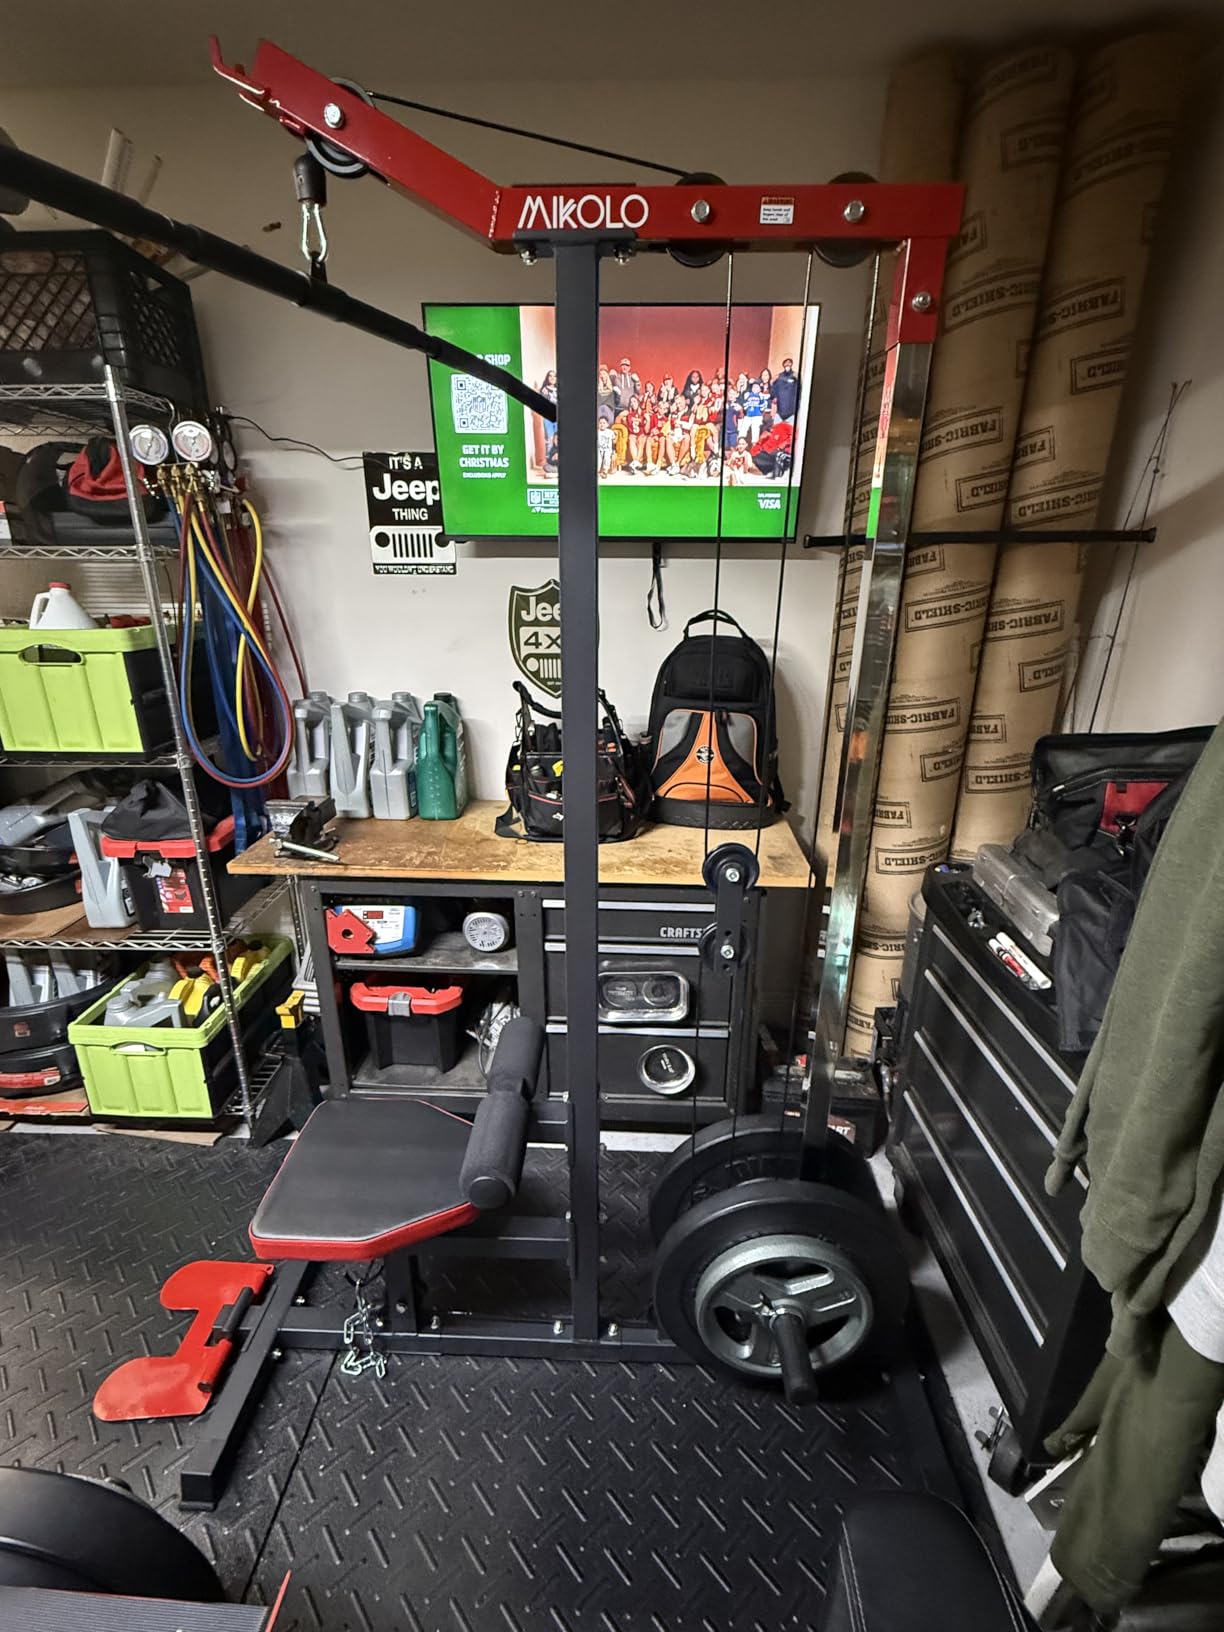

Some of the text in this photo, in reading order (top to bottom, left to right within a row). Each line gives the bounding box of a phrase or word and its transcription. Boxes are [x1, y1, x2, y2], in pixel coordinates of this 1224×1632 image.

[518, 193, 649, 229] MIKOLO
[462, 444, 504, 455] GET IT BY
[389, 455, 424, 470] IT'S A
[459, 456, 510, 468] CHRISTMAS
[372, 473, 440, 506] Jeep
[757, 498, 781, 510] VISA
[391, 507, 429, 521] THING
